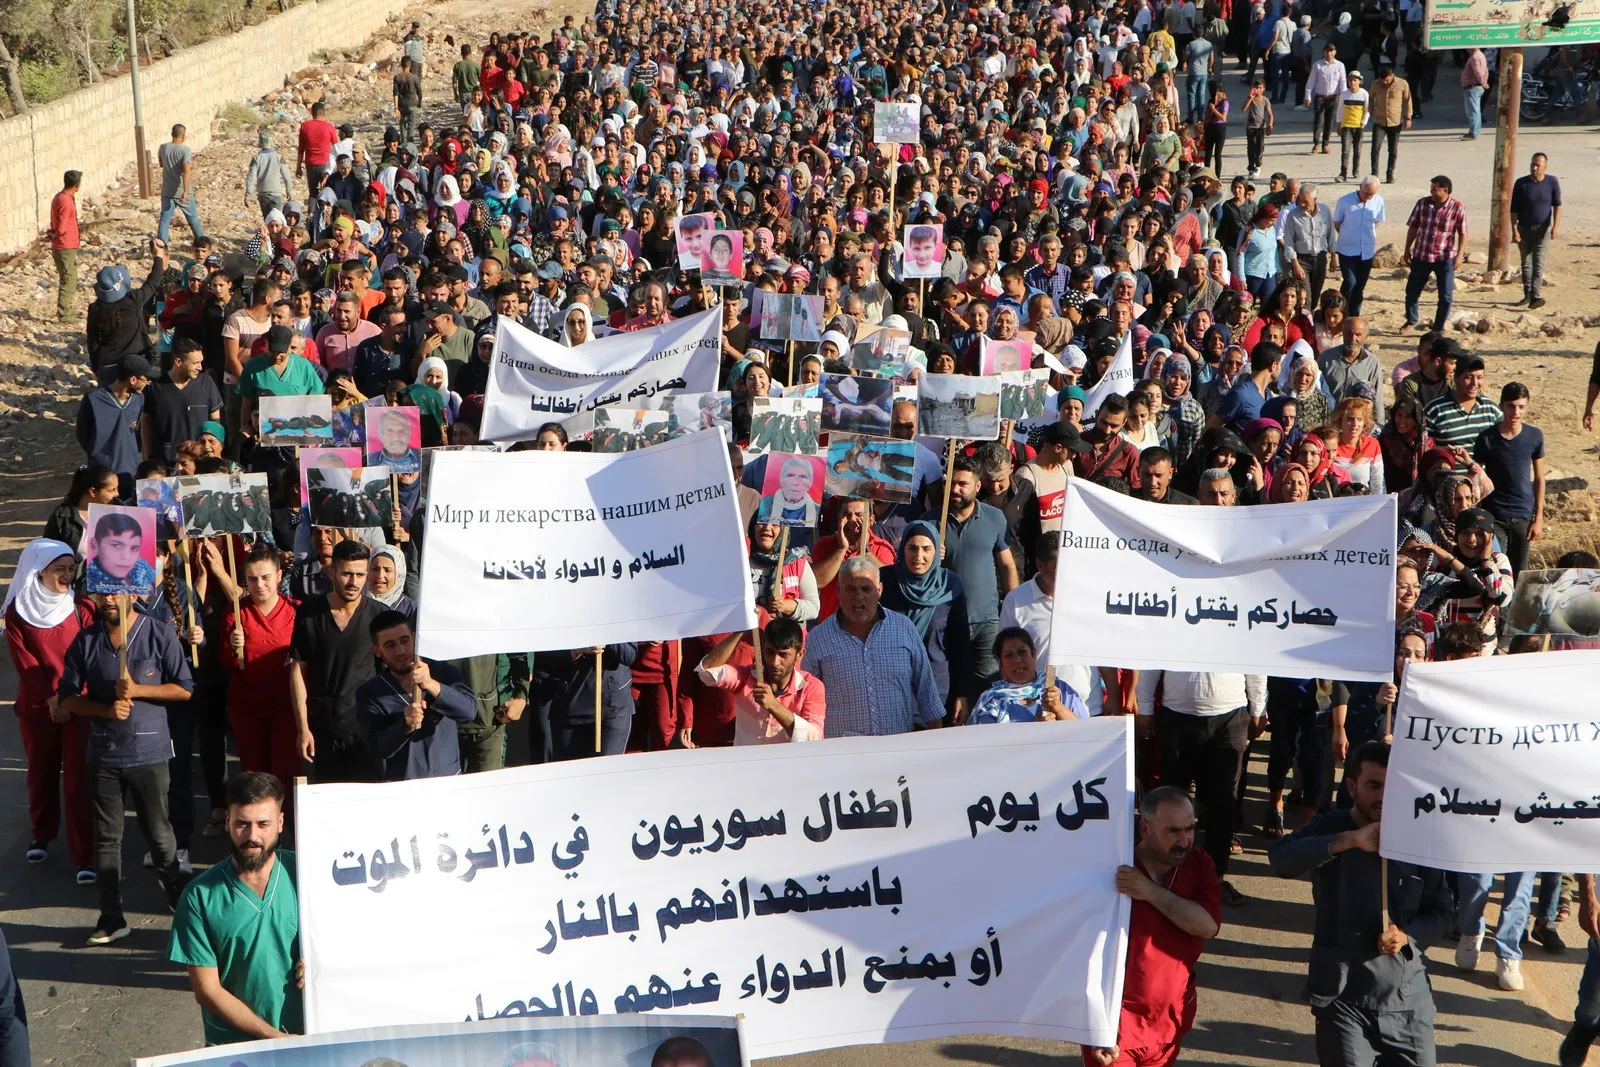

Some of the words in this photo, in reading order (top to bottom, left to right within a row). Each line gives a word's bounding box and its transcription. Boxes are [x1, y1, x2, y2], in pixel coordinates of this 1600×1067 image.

[500, 352, 535, 371] Ваша
[539, 366, 580, 379] осада
[683, 337, 720, 352] детей
[1100, 367, 1132, 383] етям
[531, 394, 583, 413] أطفالنا
[587, 389, 621, 412] يقتل
[626, 374, 687, 402] حصاركم
[433, 504, 473, 529] Мир
[479, 510, 489, 522] и
[495, 509, 596, 529] лекарства
[601, 497, 671, 520] нашим
[676, 483, 726, 511] детям
[1040, 506, 1064, 517] LACO
[629, 544, 685, 579] السلام
[1062, 528, 1111, 549] Ваша
[1115, 536, 1170, 554] осада
[1334, 549, 1390, 565] детей
[554, 556, 605, 583] الدواء
[611, 559, 622, 579] و
[1106, 586, 1176, 618] أطفالنا
[1185, 596, 1238, 627] يقتل
[1248, 598, 1338, 631] حصاركم
[1405, 716, 1503, 750] Пусть
[1513, 723, 1580, 750] дети
[803, 775, 912, 842] أطفال
[967, 792, 1040, 839] يوم
[1056, 777, 1109, 831] كل
[1414, 787, 1501, 823] بسلام
[437, 824, 535, 882] دائرة
[552, 813, 589, 880] في
[632, 809, 786, 860] سوريون
[332, 836, 421, 893] الموت
[536, 892, 639, 955] بالنار
[656, 866, 902, 944] باستهدافهم
[739, 946, 846, 1004] الدواء
[863, 946, 956, 993] بمنع
[968, 927, 1002, 986] أو
[464, 979, 600, 1021] والحصا
[613, 967, 721, 1013] عنهم
